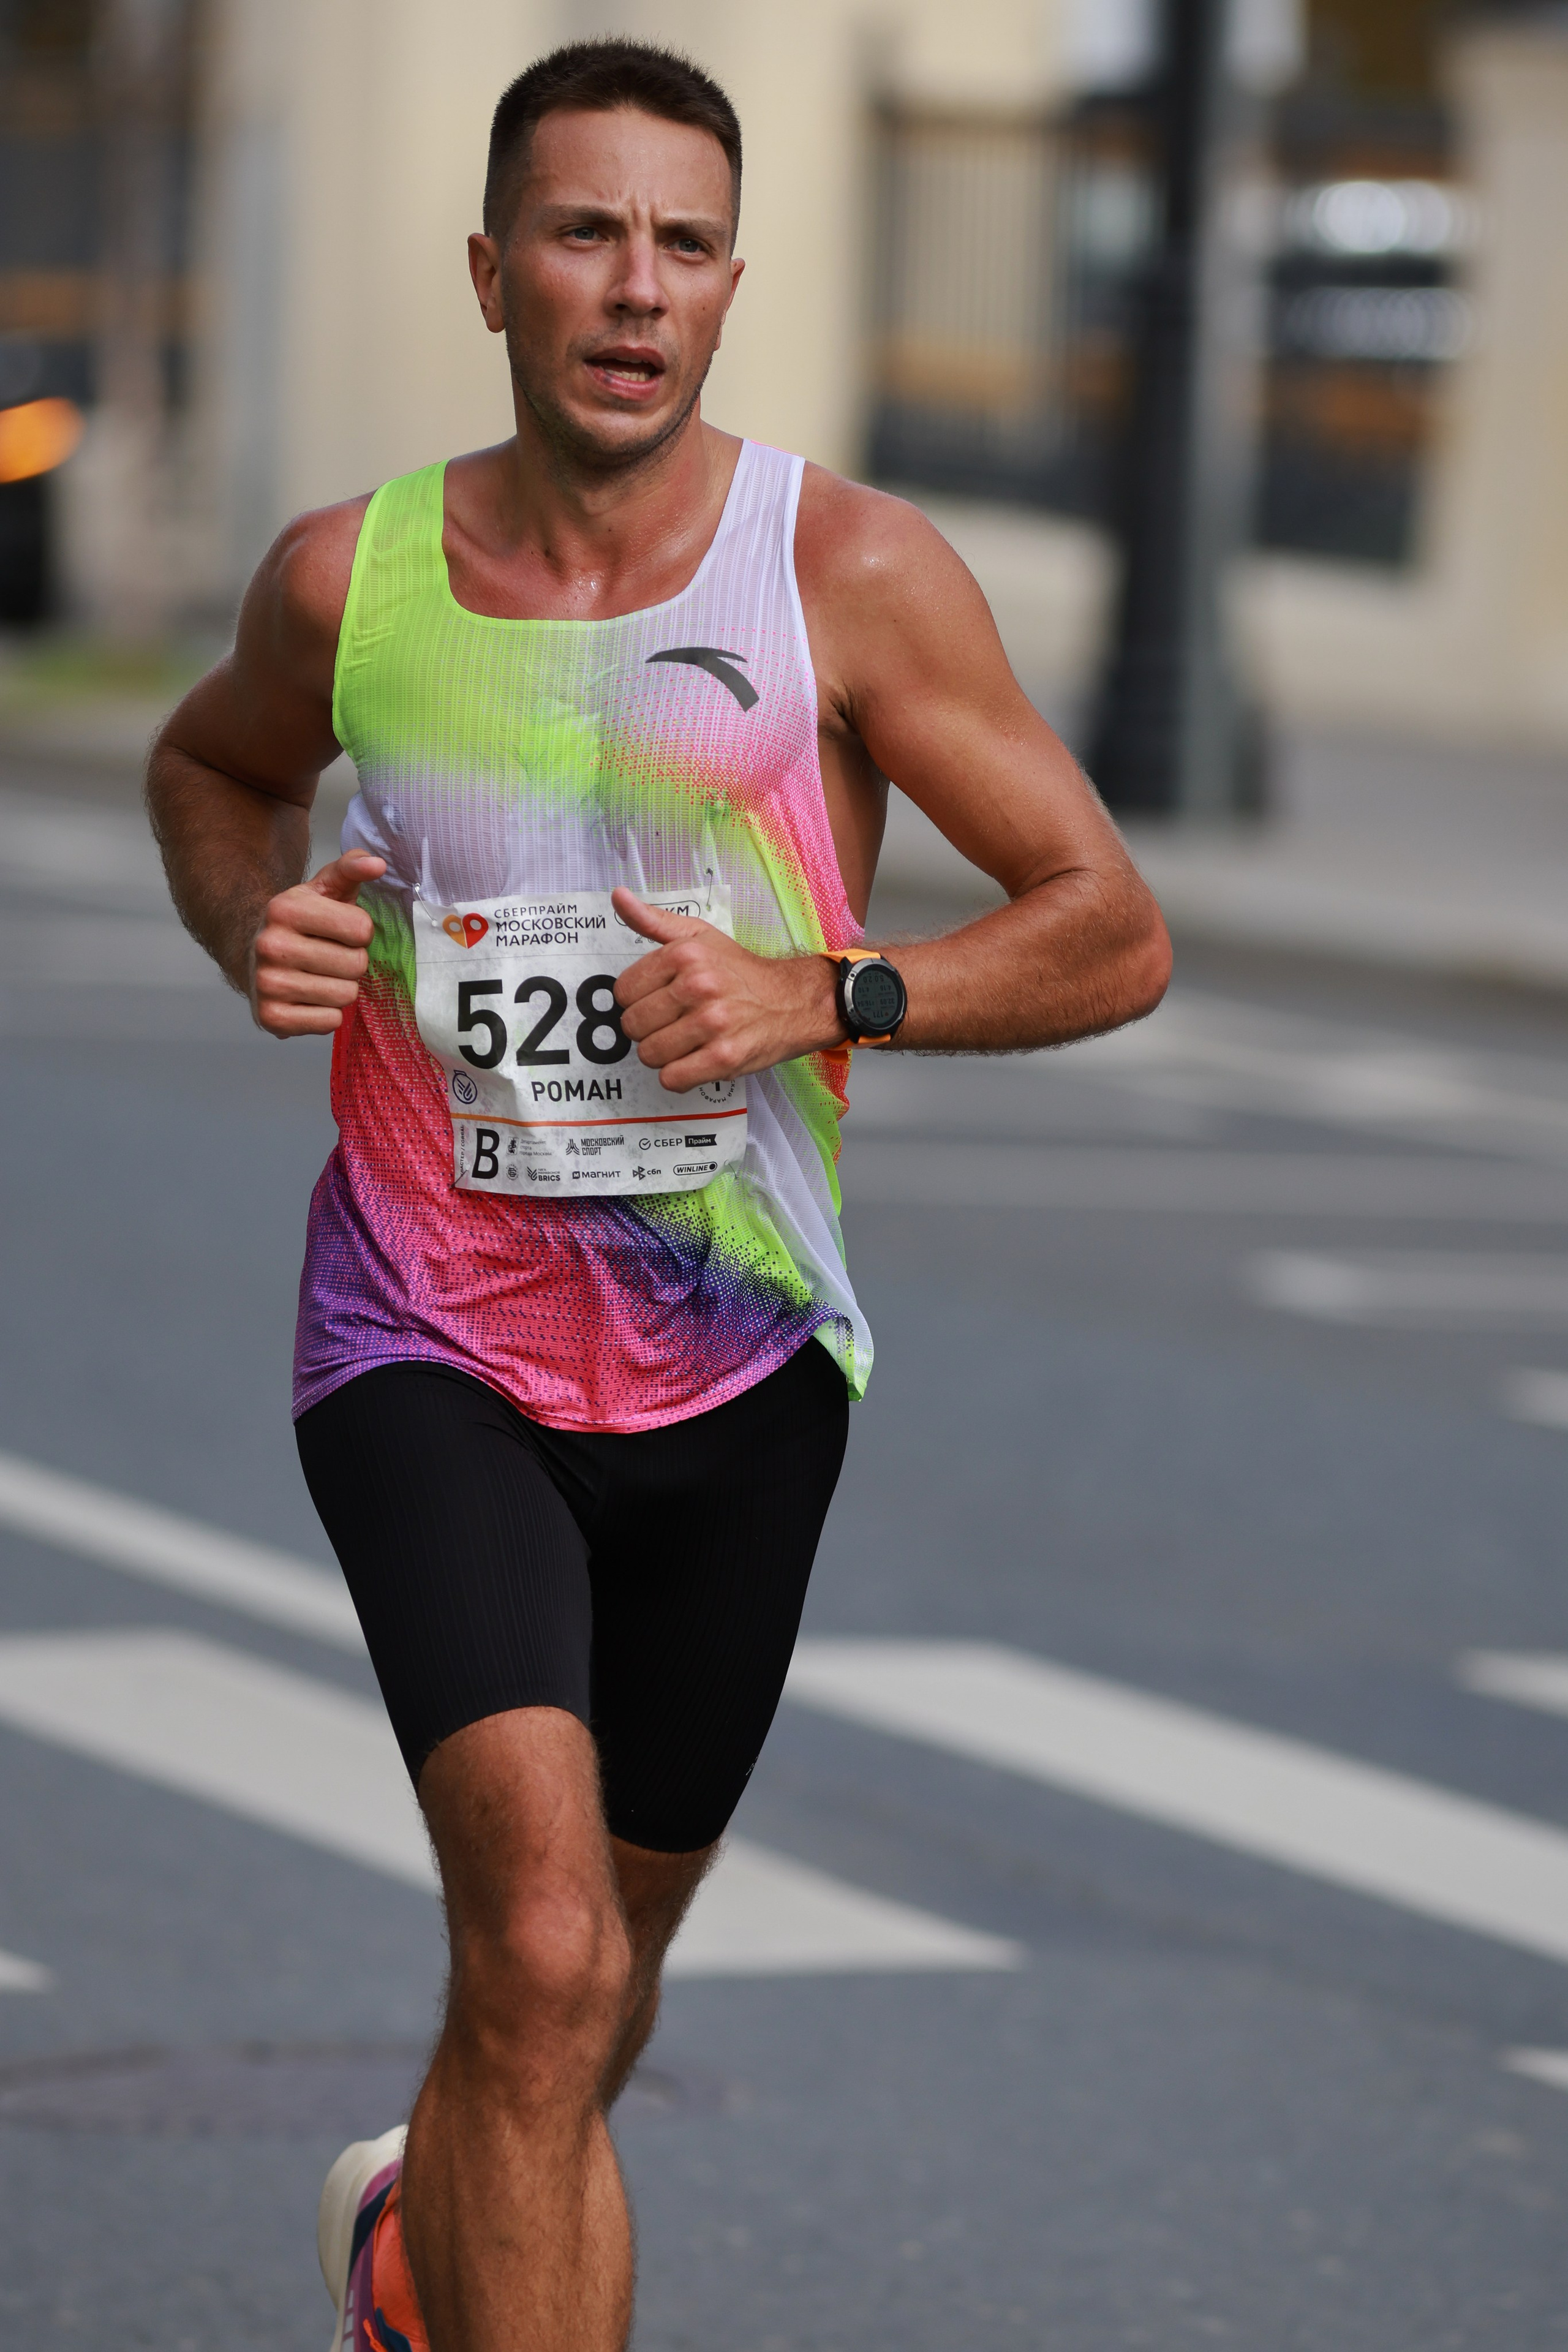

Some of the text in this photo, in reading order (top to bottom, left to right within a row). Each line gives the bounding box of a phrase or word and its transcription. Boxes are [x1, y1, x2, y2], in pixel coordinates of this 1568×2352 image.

[494, 903, 578, 918] СБЕРПРАЙМ
[496, 914, 606, 932] МОСКОВСКИЙ
[496, 932, 578, 947] МАРАФОН
[531, 1079, 622, 1102] РОМАН
[581, 1135, 624, 1147] МОСКОВСКИЙ
[654, 1138, 682, 1147] СБЕР
[472, 1128, 500, 1179] B
